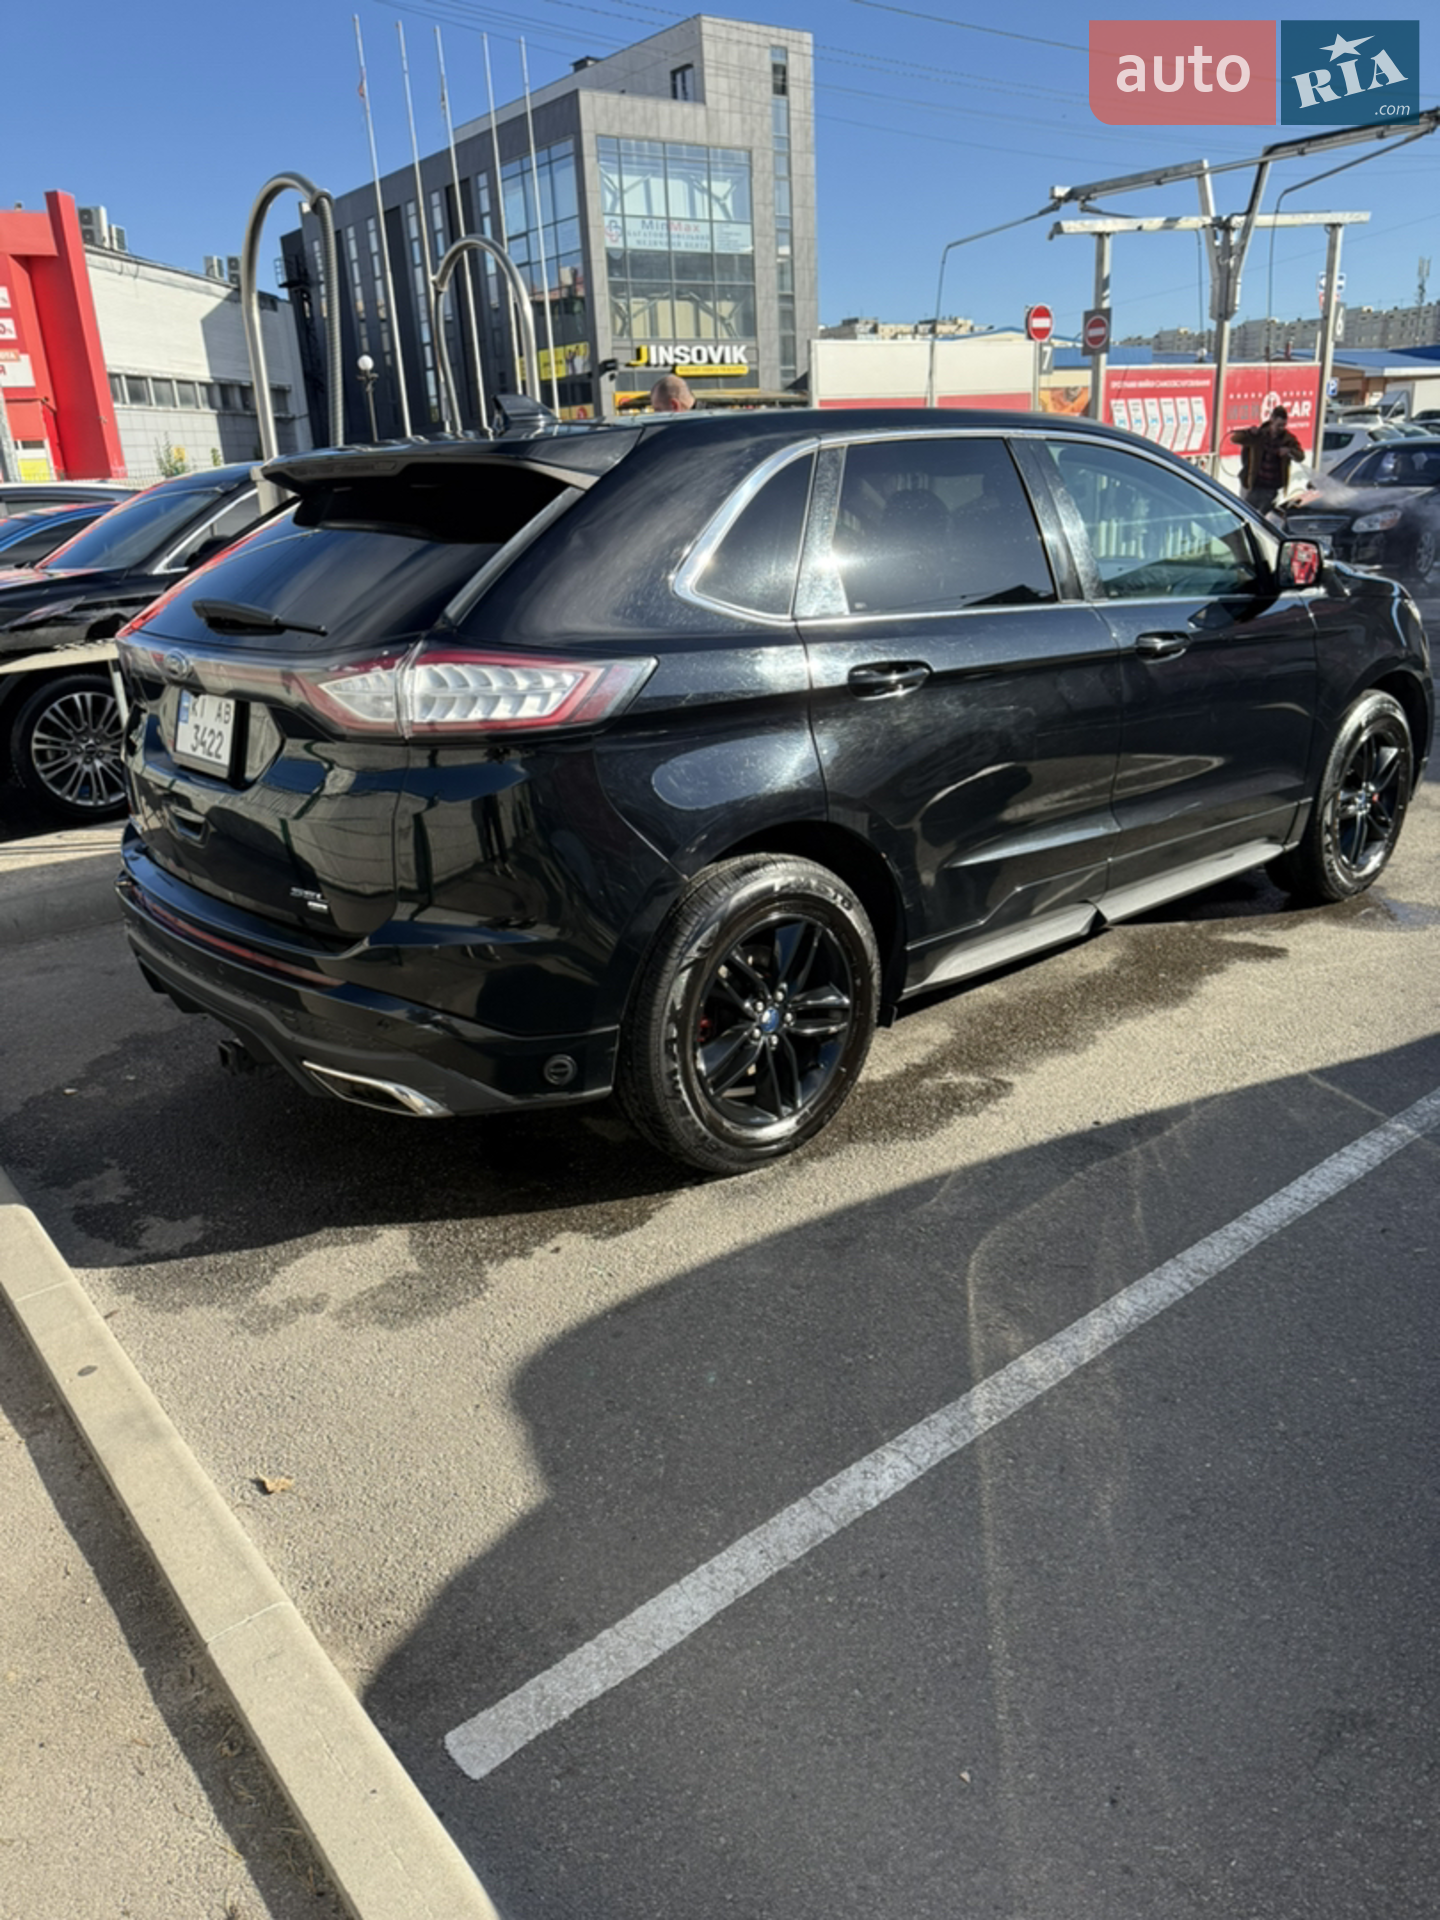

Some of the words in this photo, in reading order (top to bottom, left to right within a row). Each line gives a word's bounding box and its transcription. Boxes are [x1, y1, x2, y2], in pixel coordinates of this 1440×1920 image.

[641, 219, 701, 233] MinMax
[1335, 306, 1345, 337] 6
[628, 345, 748, 366] JINSOVIK
[1042, 346, 1052, 370] 7
[190, 724, 224, 759] 3422
